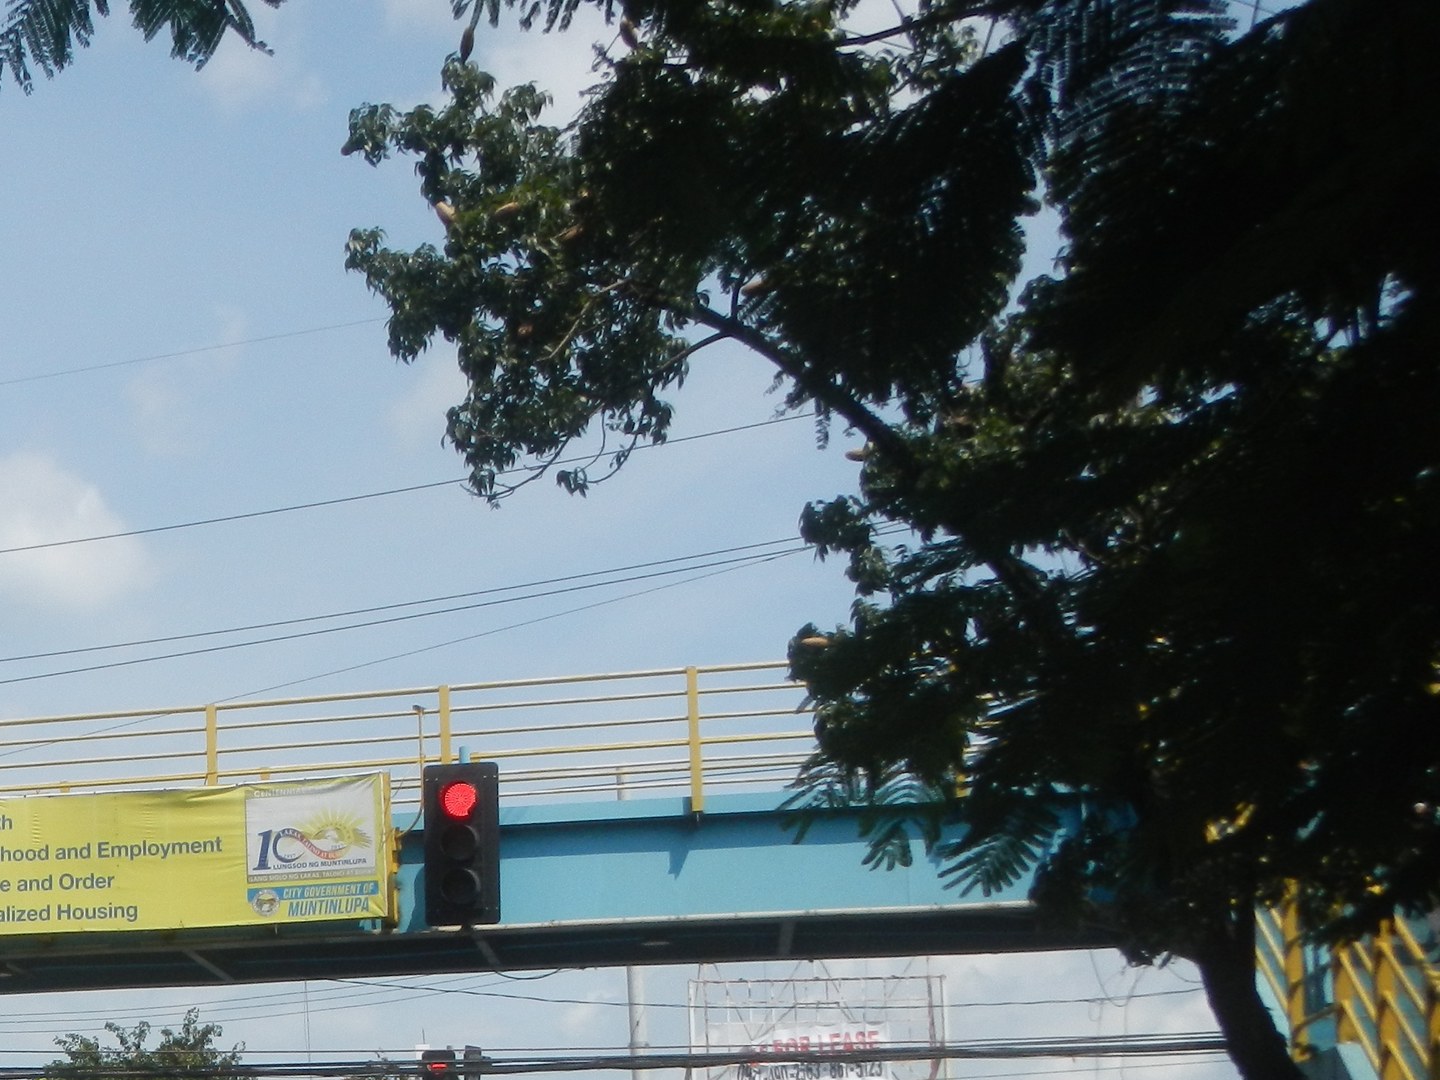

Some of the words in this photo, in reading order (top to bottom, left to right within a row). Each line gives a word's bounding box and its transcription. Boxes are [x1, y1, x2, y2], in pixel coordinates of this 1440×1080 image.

[55, 843, 91, 860] and
[97, 836, 222, 860] Employment
[273, 861, 307, 870] LUNGSOD
[320, 858, 367, 867] MUNTINLUPA
[17, 874, 53, 892] and
[59, 872, 115, 891] Order
[283, 887, 301, 898] CITY
[304, 884, 361, 897] GOVERNMENT
[363, 883, 374, 893] OF
[56, 902, 138, 922] Housing
[288, 897, 370, 917] MUNTINLUPA
